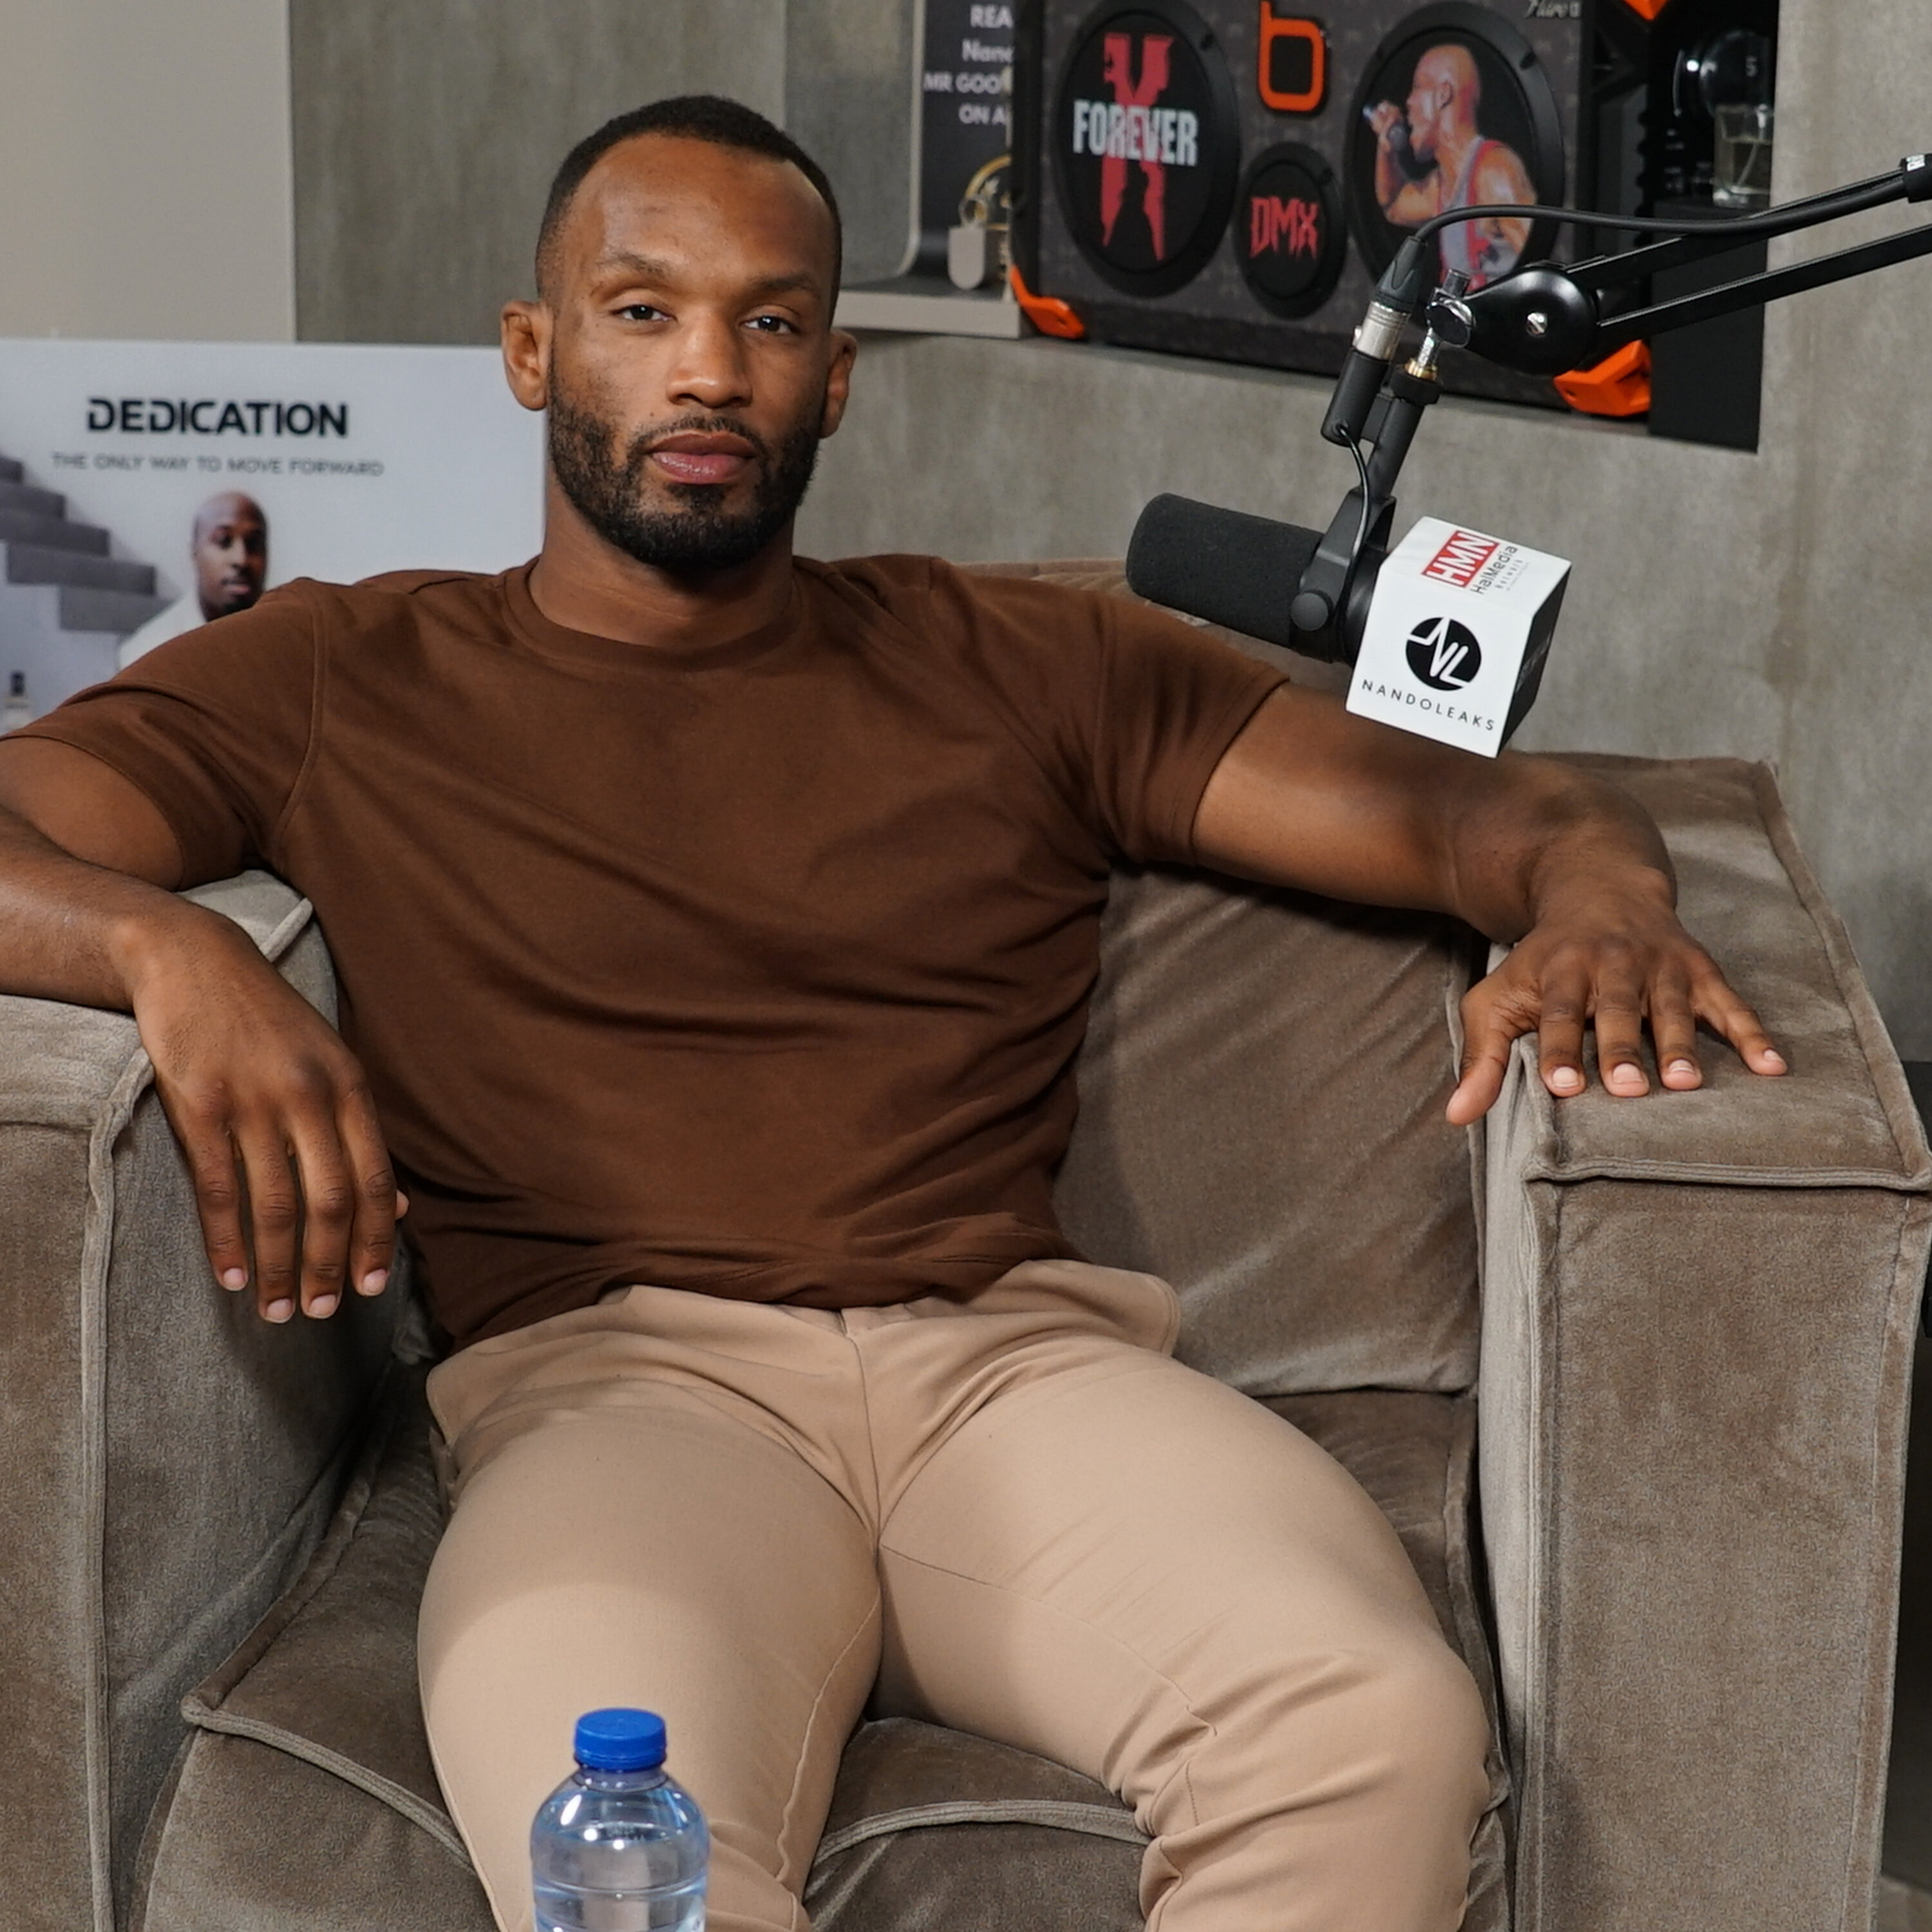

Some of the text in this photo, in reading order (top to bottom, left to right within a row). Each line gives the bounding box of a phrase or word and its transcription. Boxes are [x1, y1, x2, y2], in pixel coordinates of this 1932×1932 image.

[970, 5, 1013, 29] REA
[923, 71, 1003, 95] MR GOO
[958, 103, 990, 124] ON
[1073, 100, 1199, 167] FOREVER
[1249, 196, 1318, 259] DMX
[88, 398, 349, 438] DEDICATION
[52, 453, 385, 477] THE ONLY WAY TO MOVE FORWARD
[1424, 531, 1497, 587] HMN
[1470, 545, 1518, 595] HalMedia
[1361, 679, 1495, 732] NANDOLEAKS
